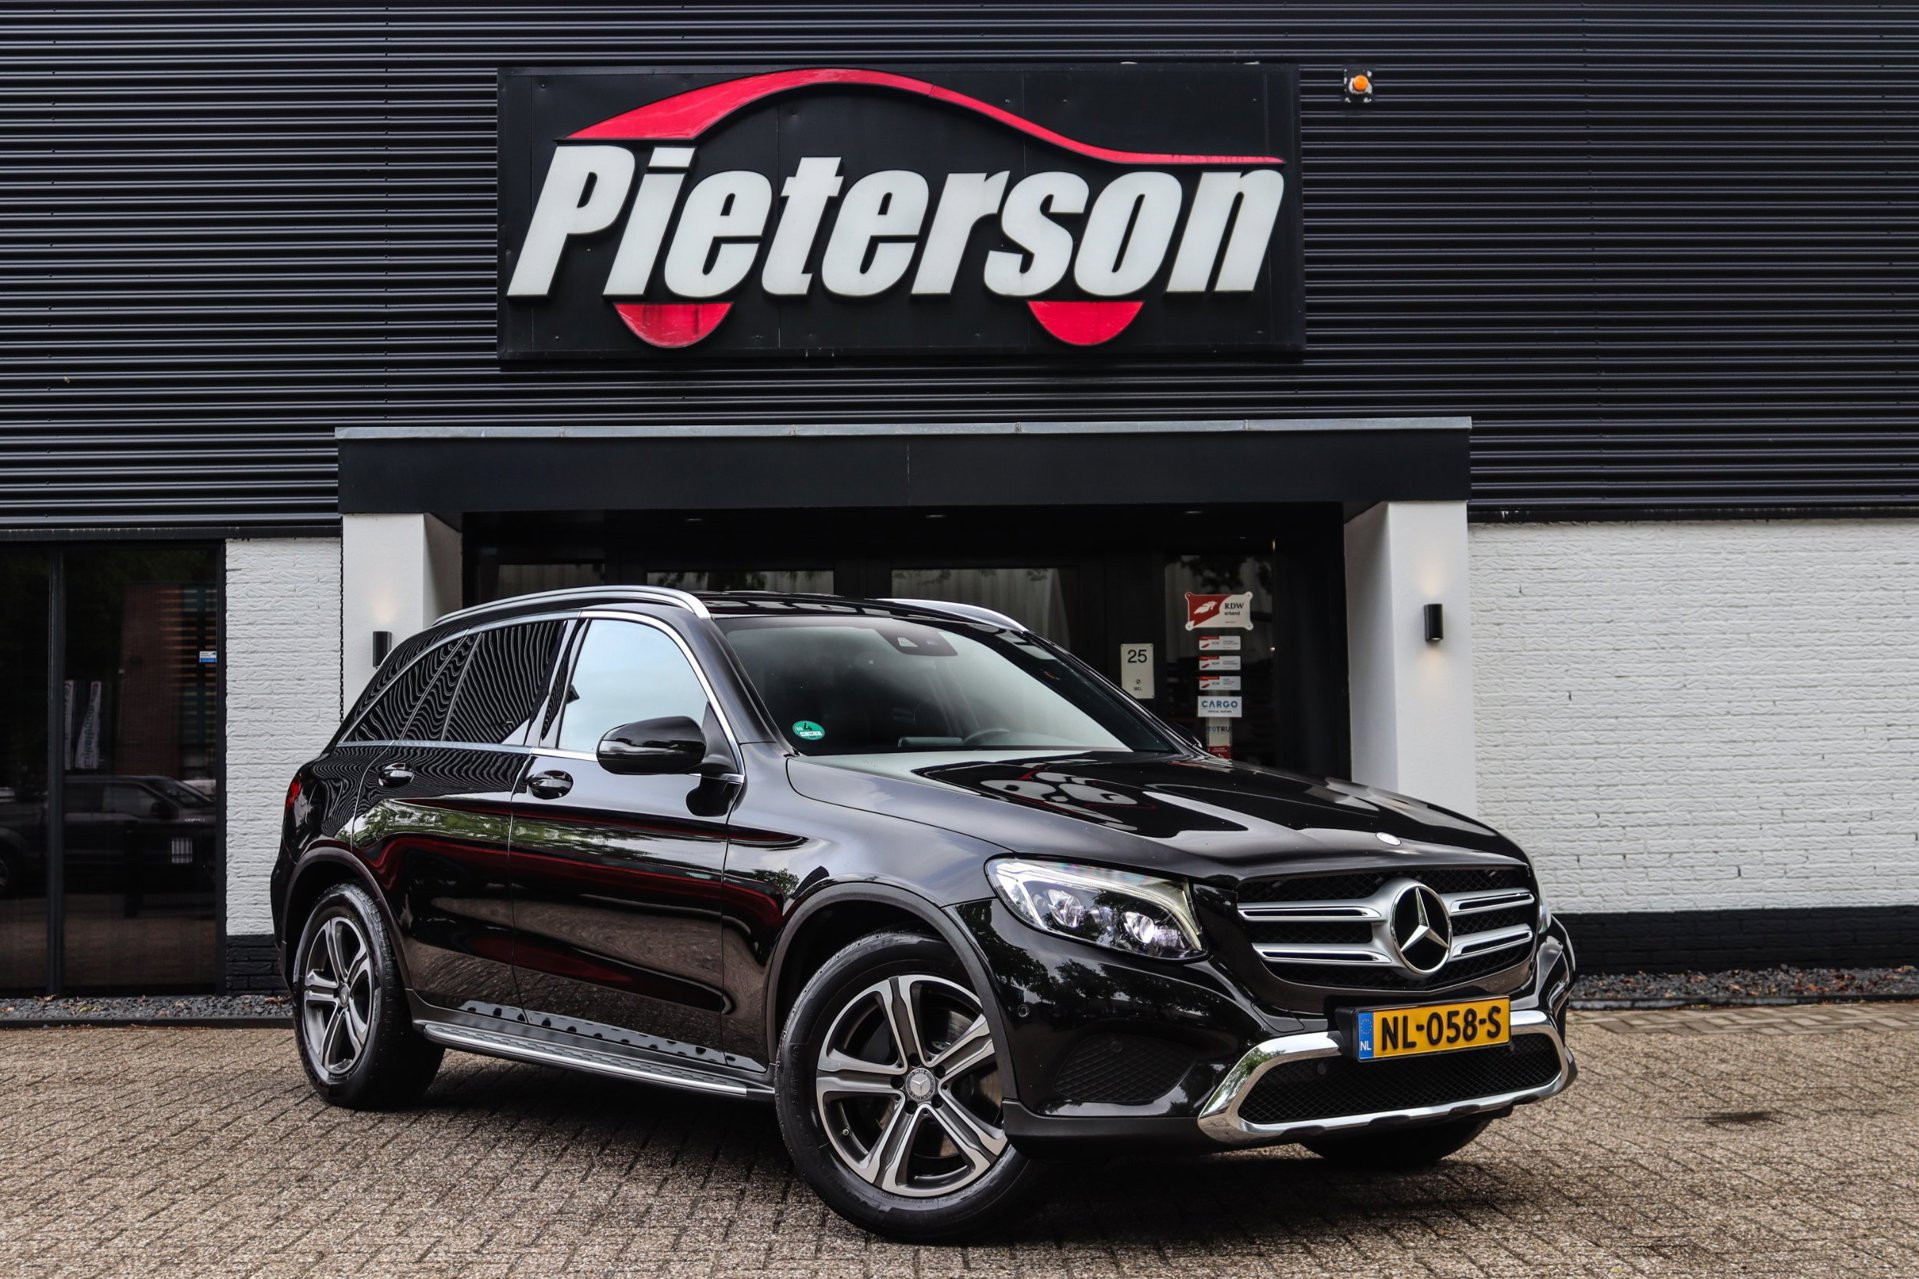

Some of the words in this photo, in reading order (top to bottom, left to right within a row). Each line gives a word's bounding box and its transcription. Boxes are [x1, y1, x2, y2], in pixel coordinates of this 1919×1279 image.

[508, 145, 1285, 299] Pieterson
[1224, 602, 1245, 610] RDW
[1127, 649, 1148, 663] 25
[1201, 700, 1238, 708] CARGO
[1381, 1005, 1502, 1051] NL-058-S
[1360, 1041, 1372, 1051] NL
